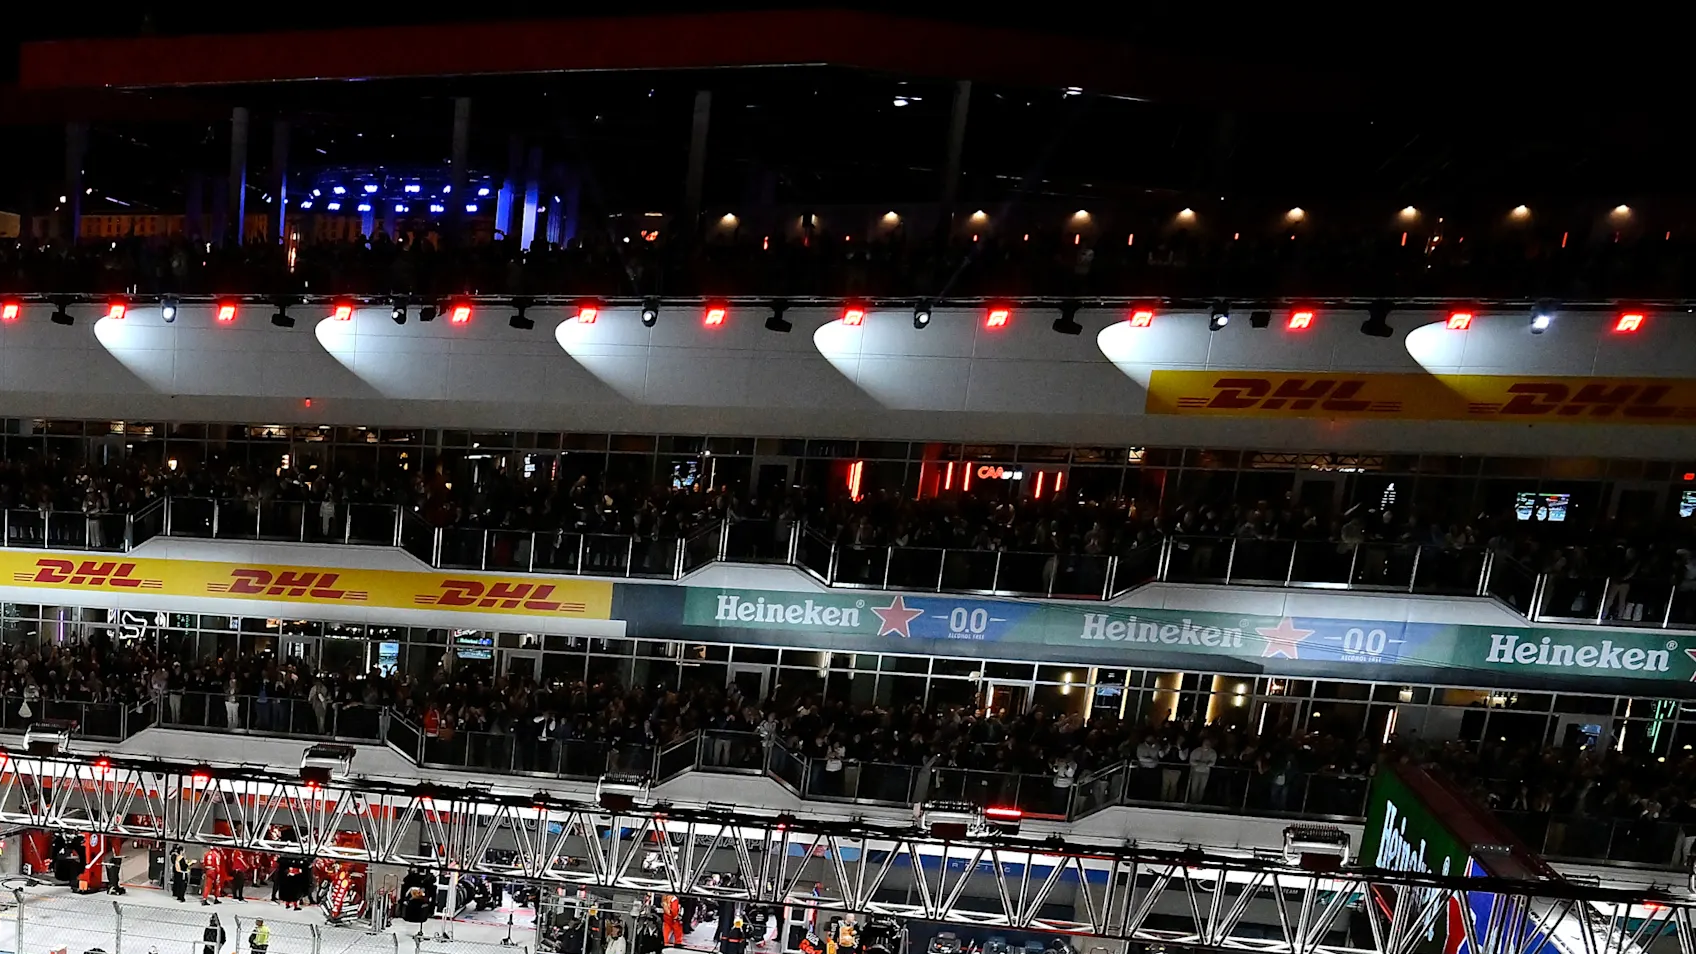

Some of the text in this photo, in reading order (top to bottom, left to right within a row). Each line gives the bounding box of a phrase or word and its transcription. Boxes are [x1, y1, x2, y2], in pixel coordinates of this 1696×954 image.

[1206, 377, 1375, 412] DHL
[1496, 382, 1676, 417] DHL
[33, 558, 142, 587] DHL
[226, 569, 346, 598] DHL
[435, 580, 563, 611] DHL
[949, 607, 988, 634] 0.0
[1344, 628, 1384, 656] 0.0
